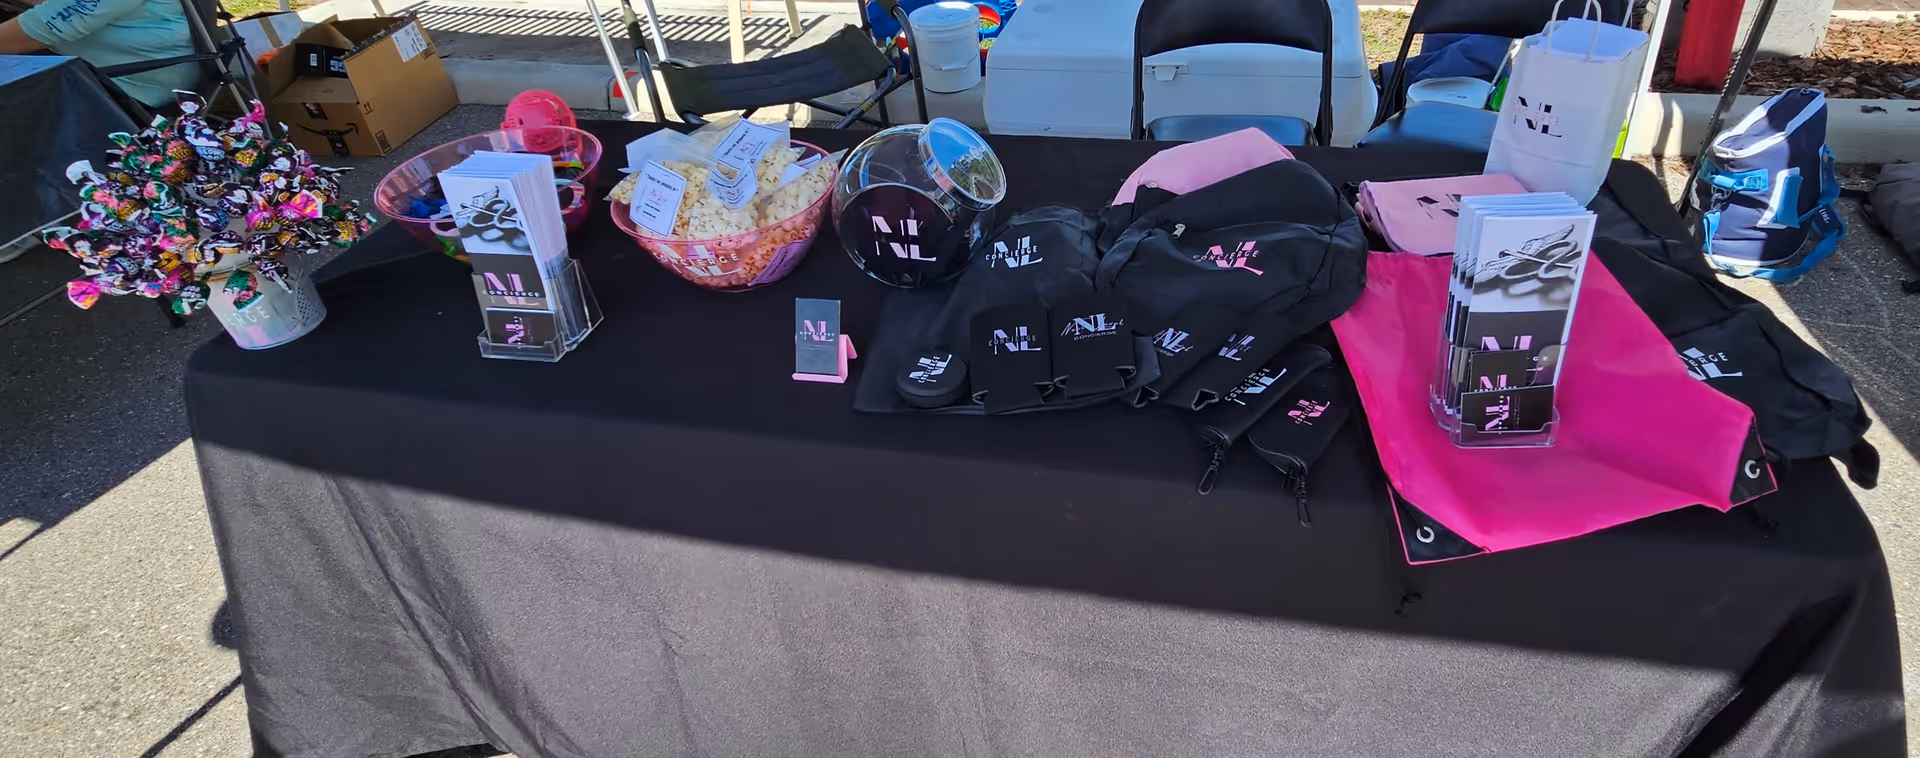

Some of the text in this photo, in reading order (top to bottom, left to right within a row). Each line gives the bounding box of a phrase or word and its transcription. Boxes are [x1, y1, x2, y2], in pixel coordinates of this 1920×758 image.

[1512, 95, 1563, 138] NL
[872, 215, 937, 262] NL
[985, 245, 1038, 260] CONCIERGE
[991, 236, 1043, 268] NL
[656, 243, 742, 276] NL
[1193, 250, 1259, 262] CONCIERGE
[1206, 241, 1264, 276] NL
[484, 272, 540, 305] NL
[804, 320, 834, 342] NL
[1071, 313, 1117, 335] NL
[994, 326, 1041, 355] NL
[909, 354, 952, 383] NL
[1224, 367, 1271, 402] CONCIERGE
[1288, 399, 1330, 426] NL
